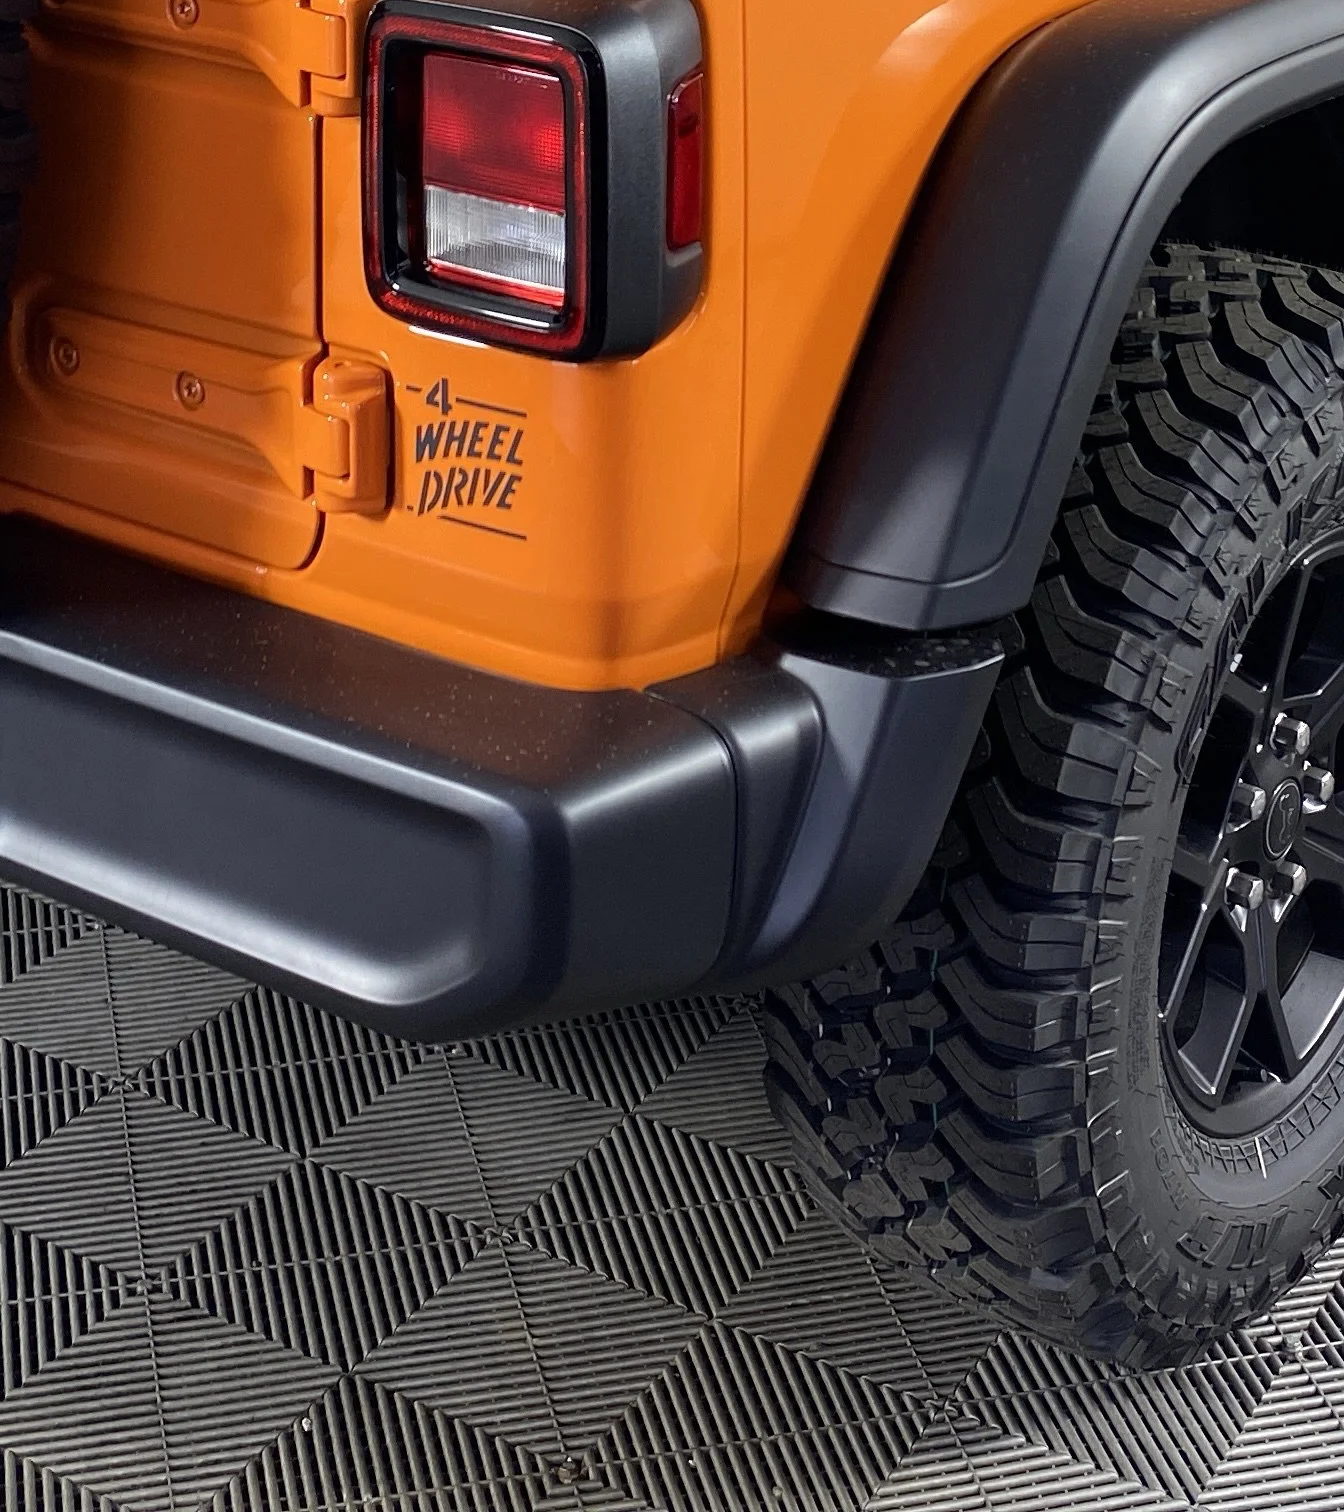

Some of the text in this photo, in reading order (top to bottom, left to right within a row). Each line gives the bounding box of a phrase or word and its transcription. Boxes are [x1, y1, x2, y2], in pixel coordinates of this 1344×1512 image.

[426, 377, 452, 416] 4
[416, 420, 523, 466] WHEEL
[417, 467, 523, 517] DRIVE
